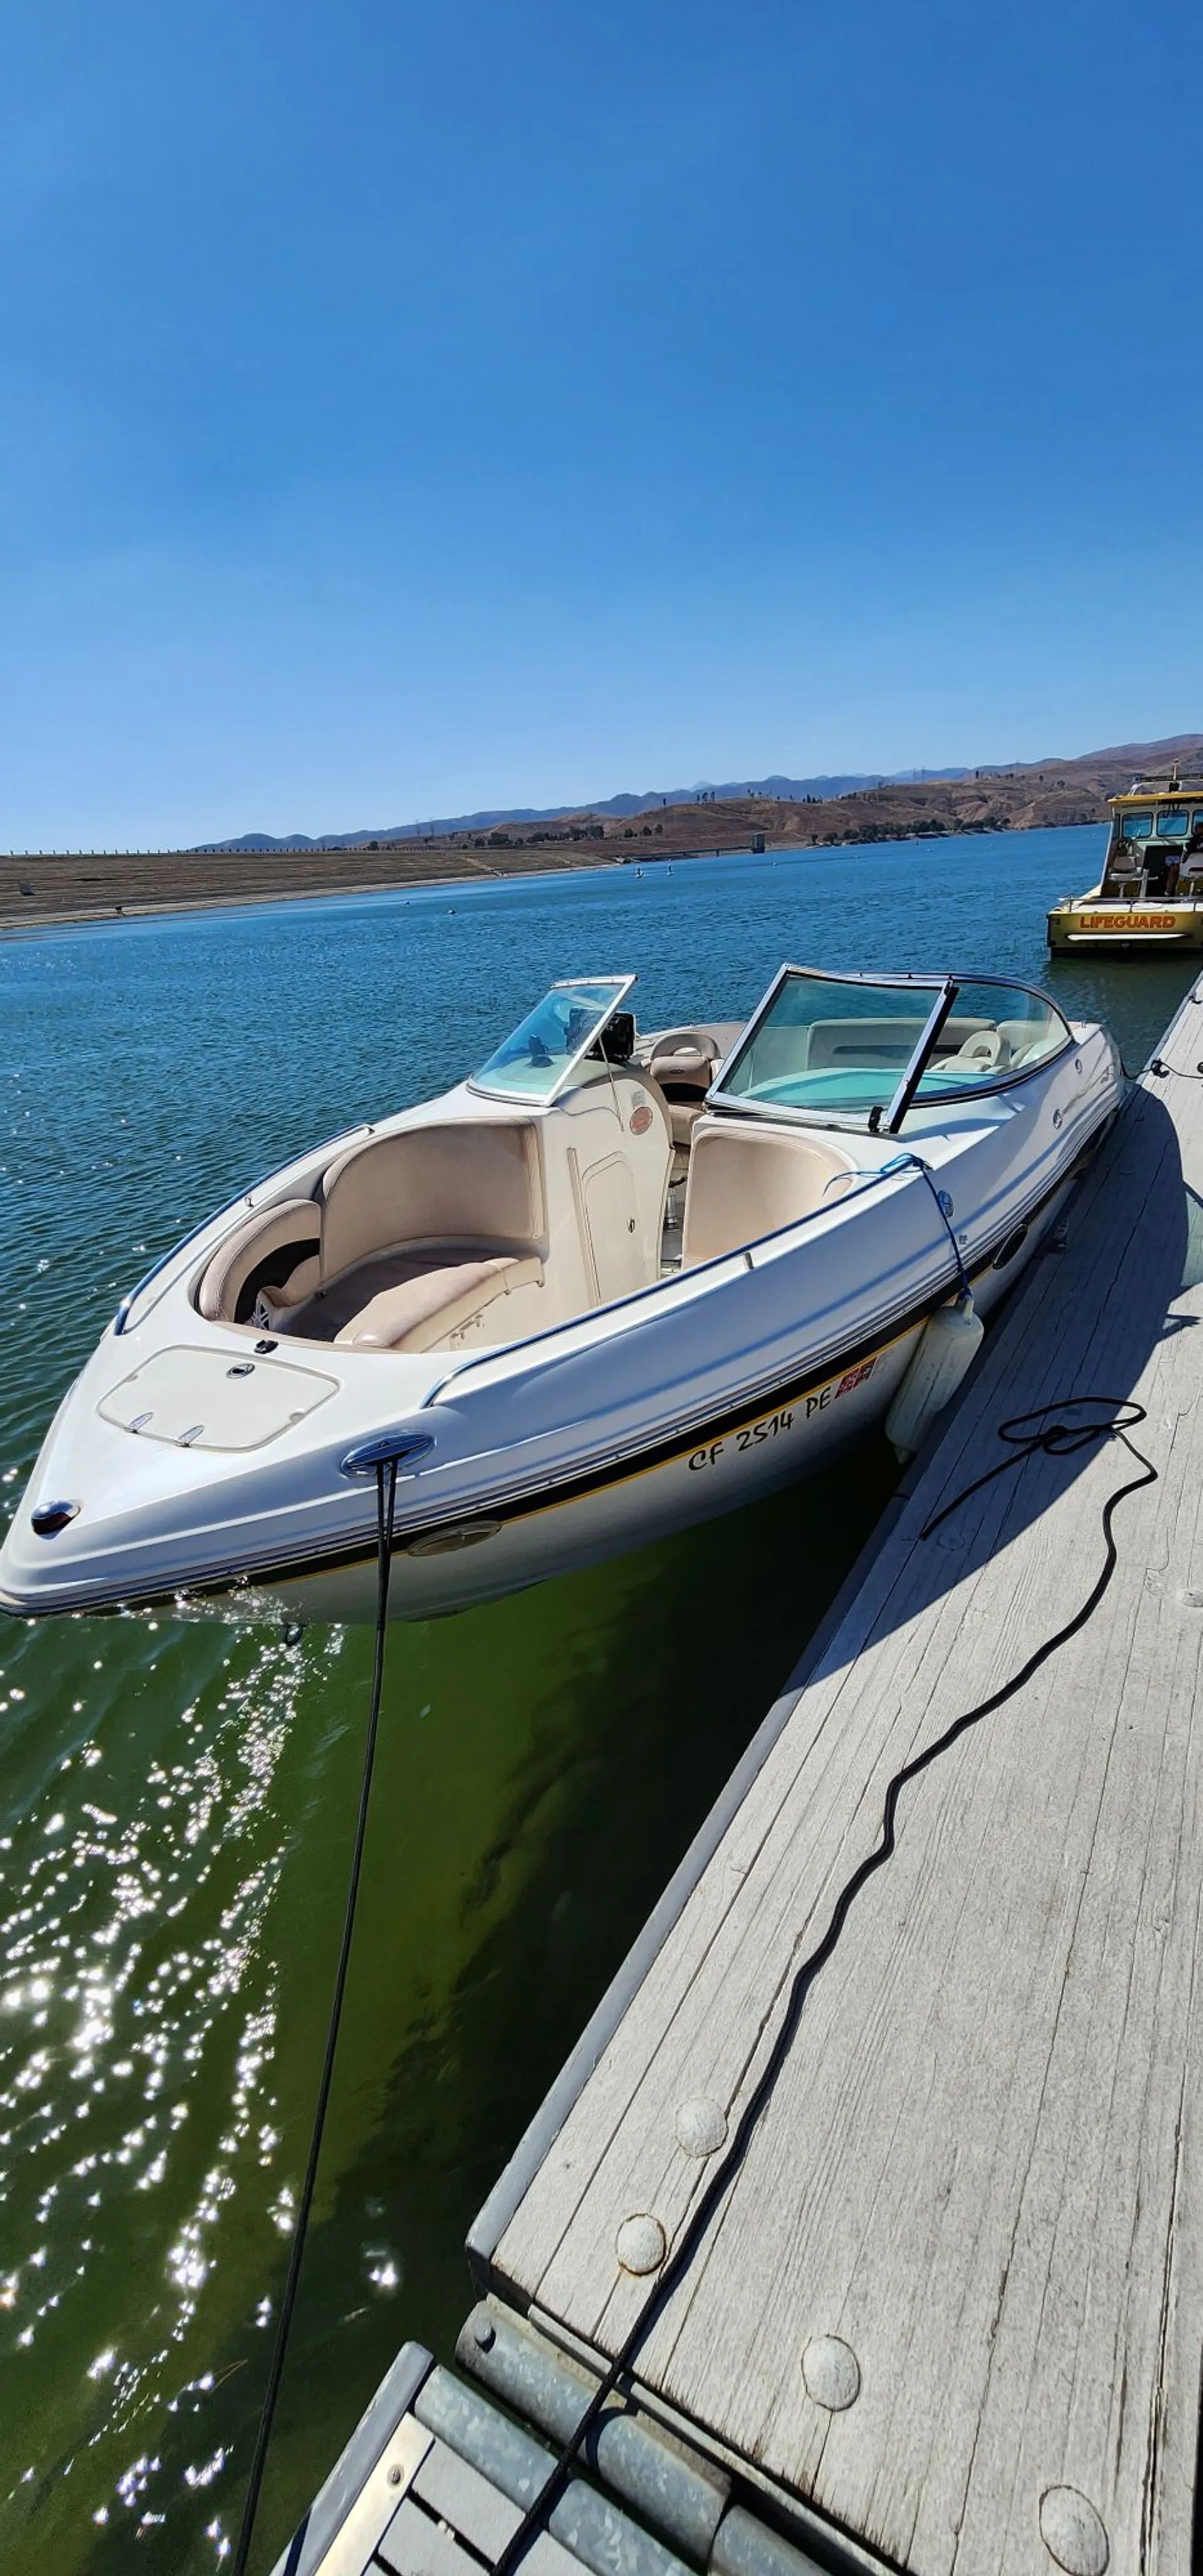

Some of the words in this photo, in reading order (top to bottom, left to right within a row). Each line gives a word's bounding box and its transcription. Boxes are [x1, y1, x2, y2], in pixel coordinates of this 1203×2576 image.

[1080, 916, 1175, 928] LIFEGUARD
[689, 1442, 723, 1470] CF
[736, 1411, 794, 1451] 2514
[806, 1387, 832, 1418] PE
